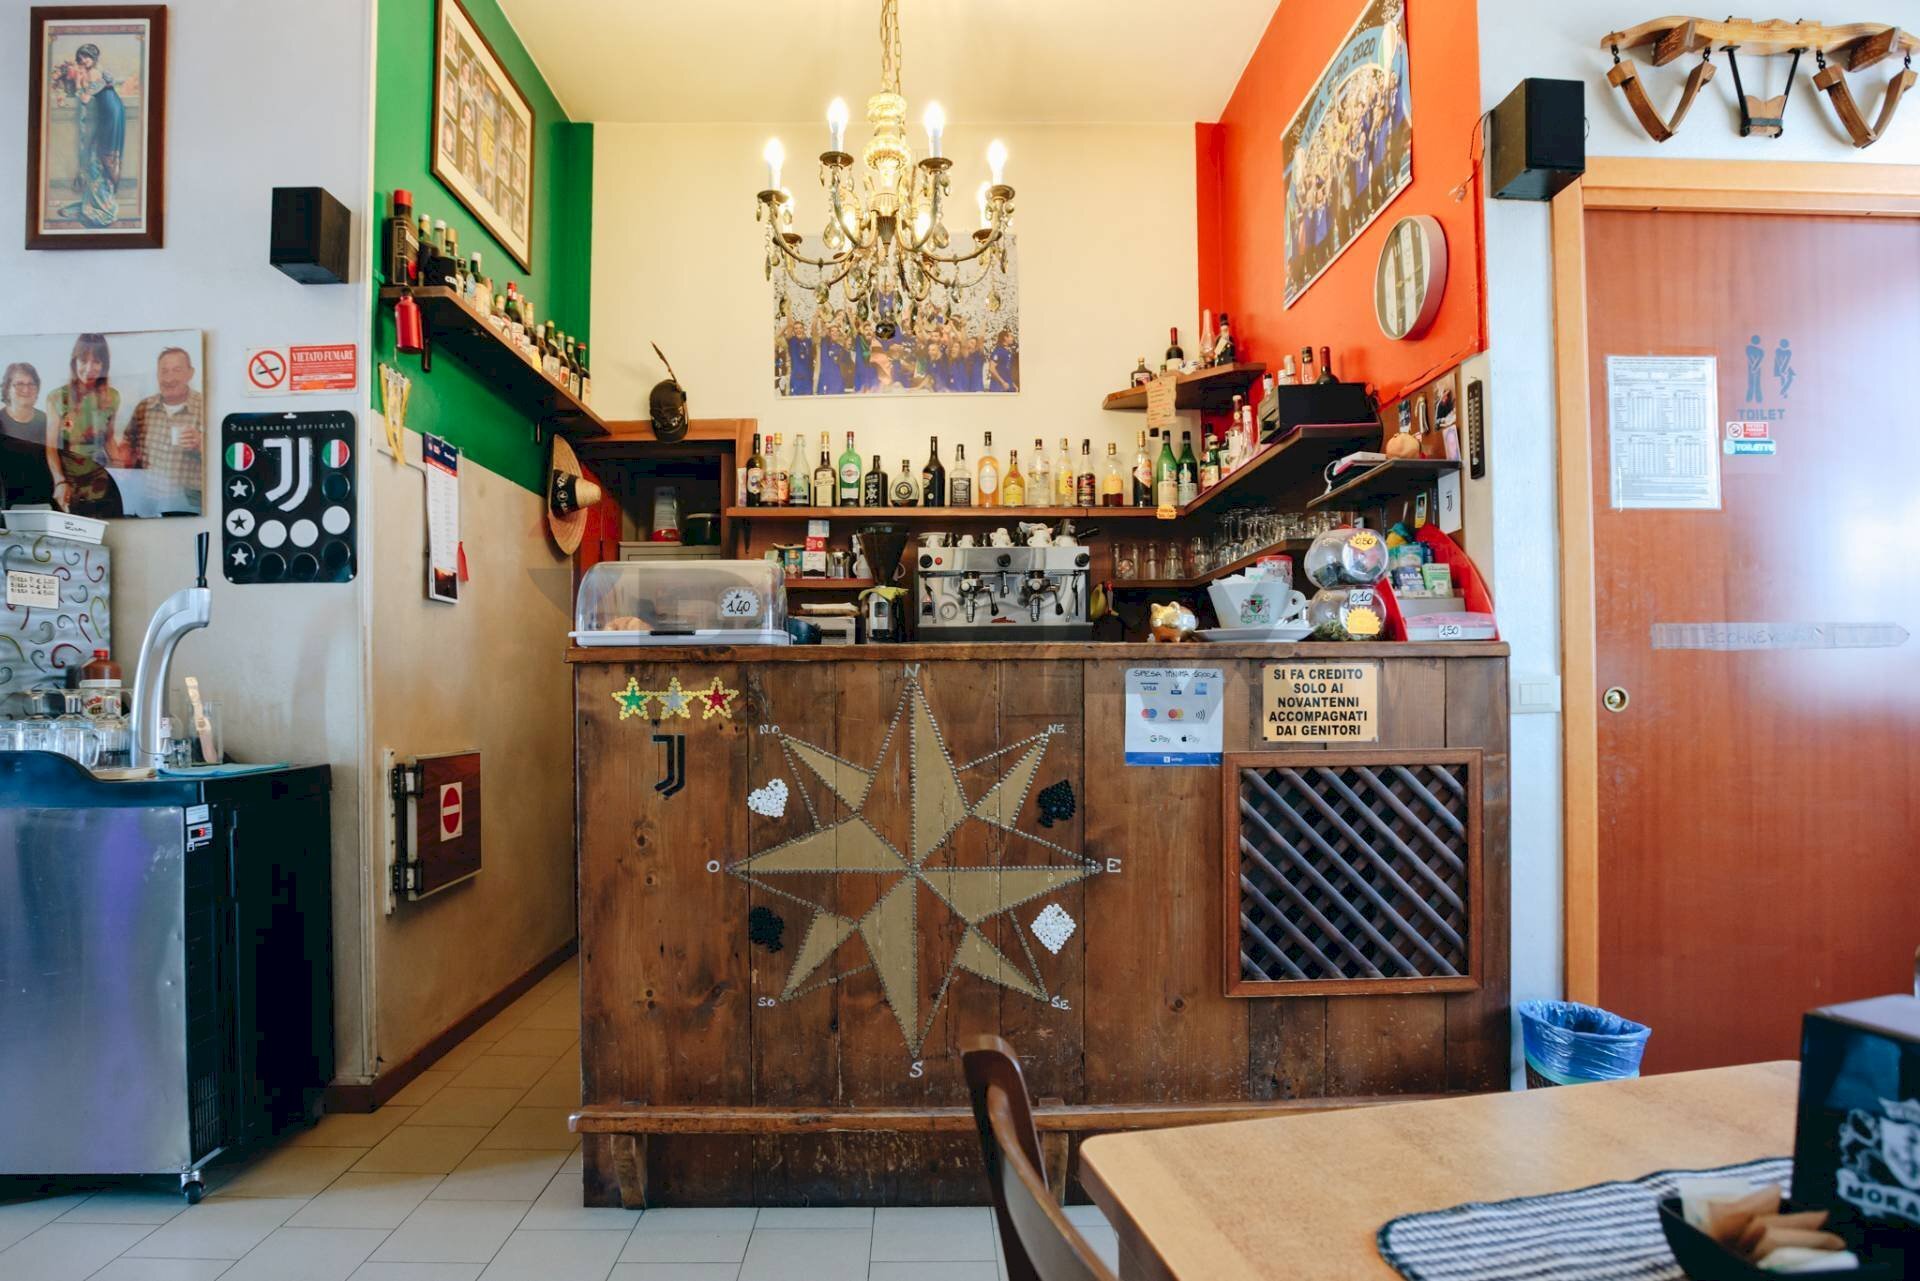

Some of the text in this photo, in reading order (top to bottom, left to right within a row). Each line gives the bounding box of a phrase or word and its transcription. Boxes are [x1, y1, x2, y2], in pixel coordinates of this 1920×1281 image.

[1351, 37, 1376, 63] 2020
[292, 350, 353, 362] VIETATO FUMARE
[1737, 408, 1785, 420] TOILET
[231, 422, 345, 432] CALENDARIO OFFICIALE
[1351, 591, 1372, 604] 0,10
[726, 600, 751, 615] 1,40
[1440, 625, 1459, 637] 1,50
[904, 663, 920, 678] N
[1273, 669, 1363, 680] SI FA CREDITO
[1293, 683, 1344, 694] SOLO AI
[1277, 697, 1360, 708] NOVANTENNI
[1268, 711, 1368, 722] ACCOMPAGNATI
[1276, 725, 1361, 736] DAI GENITORI
[1106, 858, 1121, 872] E
[909, 1060, 924, 1078] S
